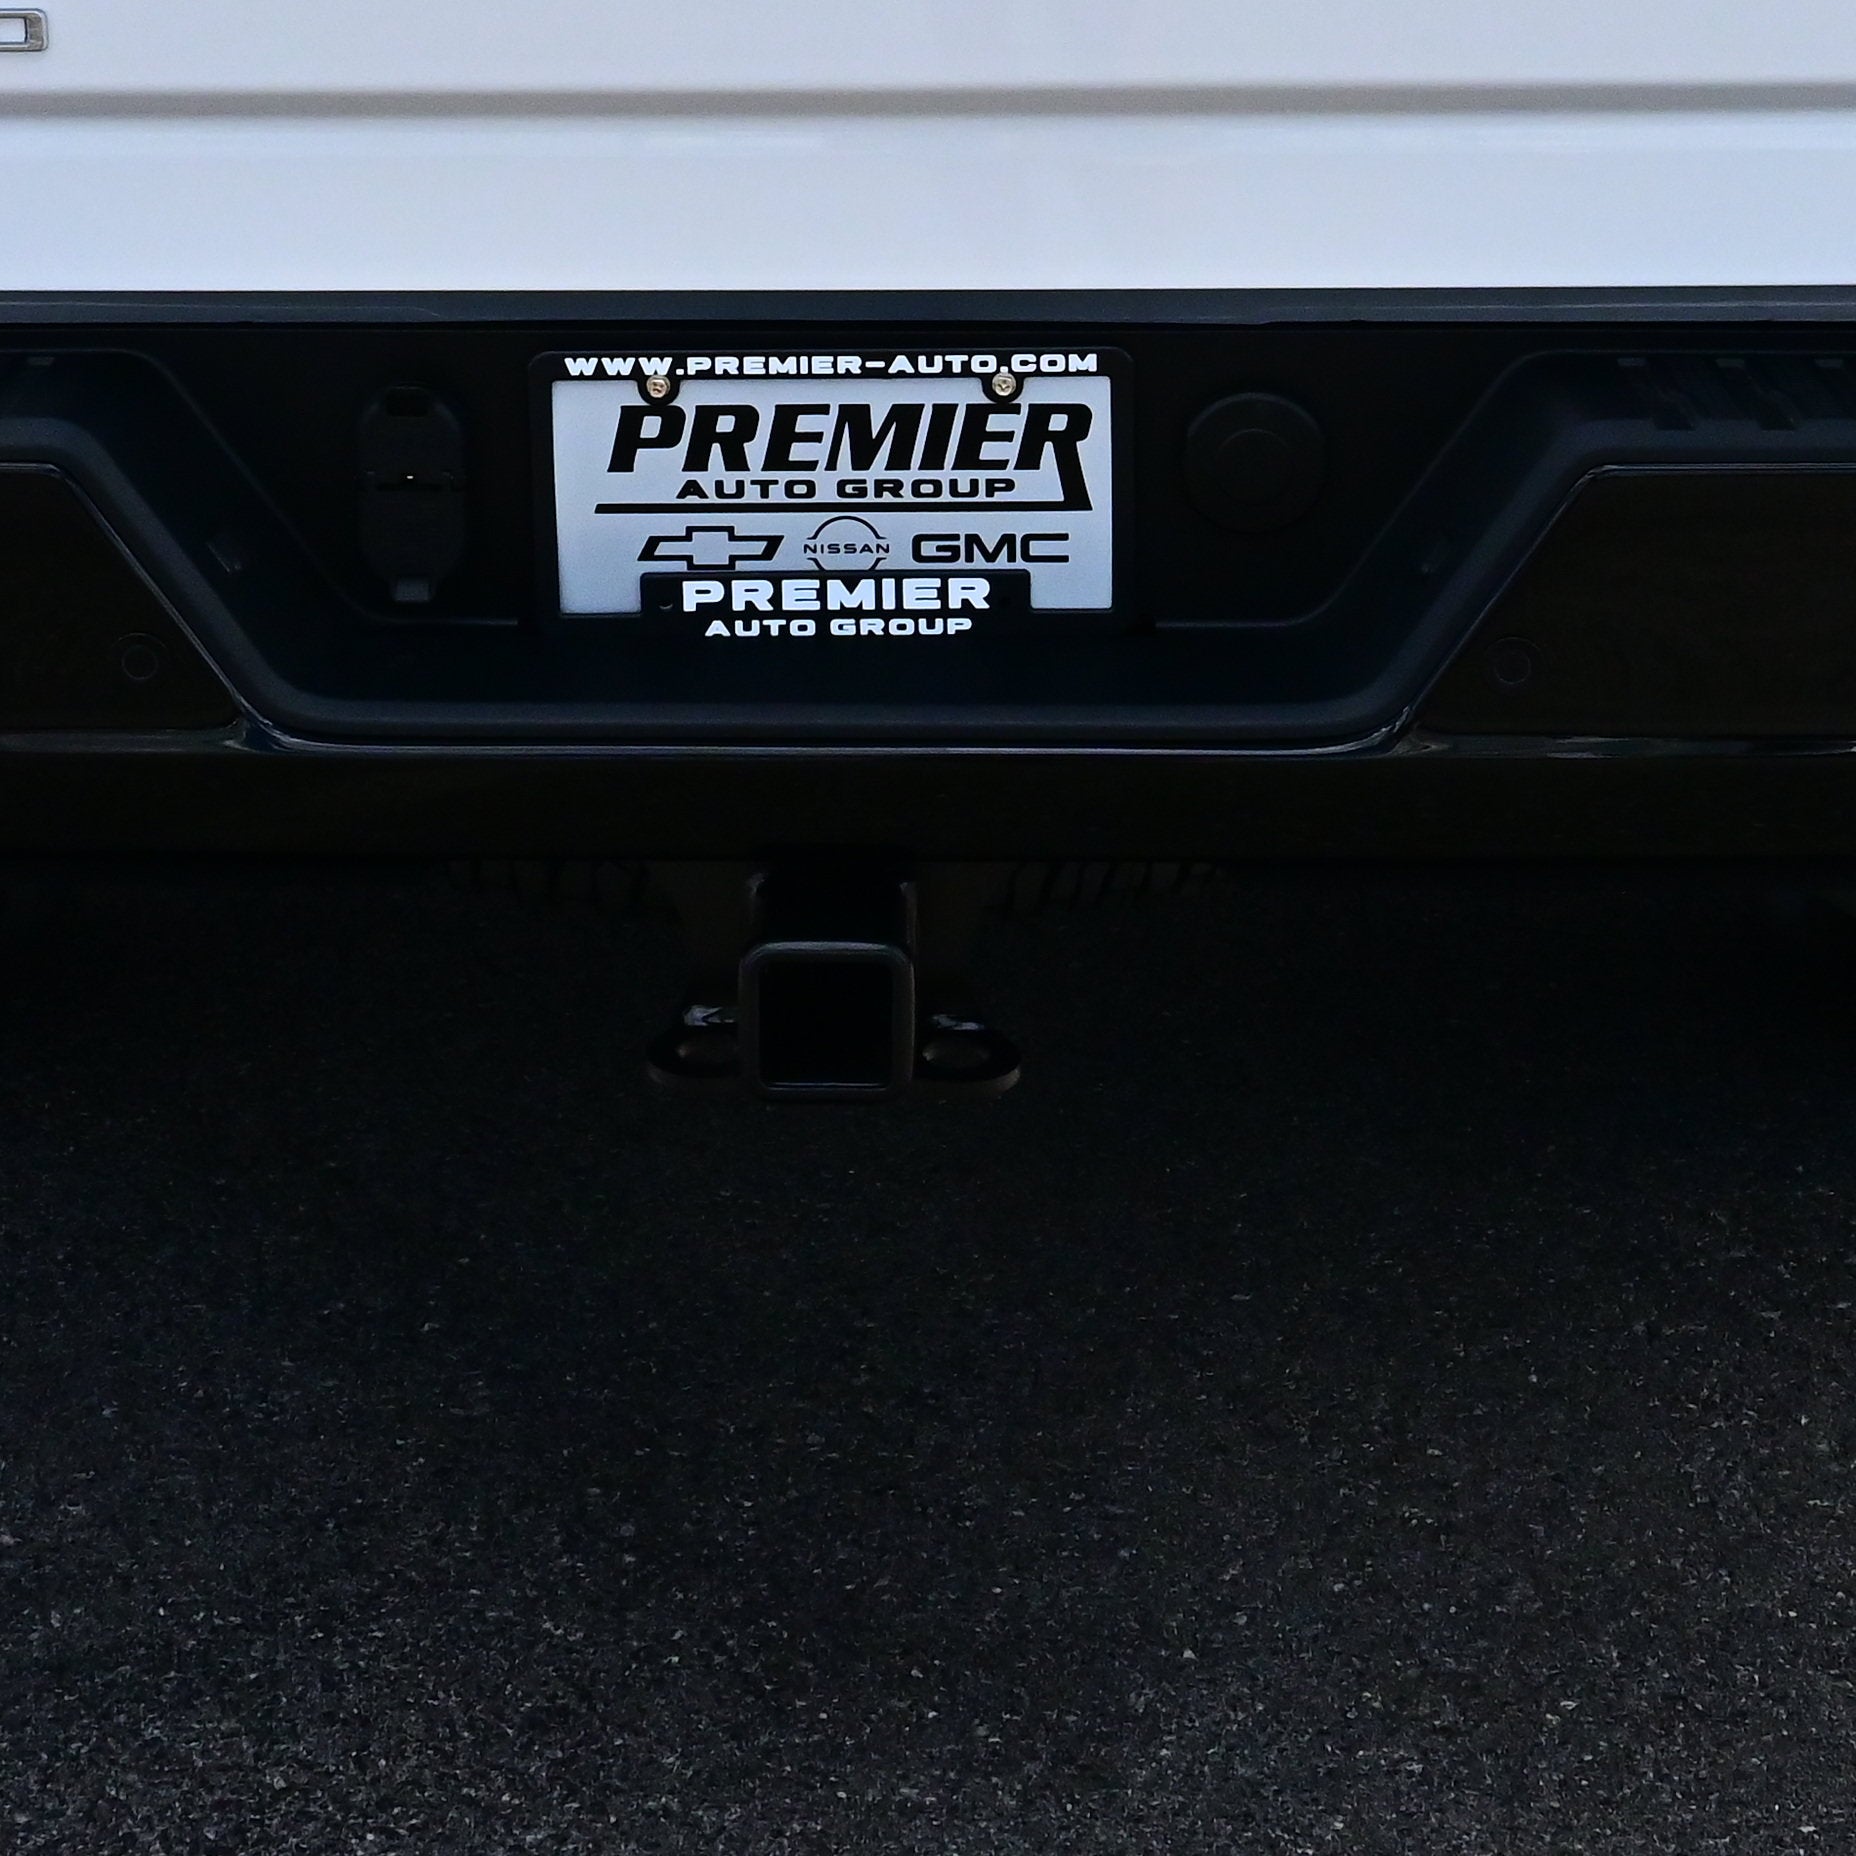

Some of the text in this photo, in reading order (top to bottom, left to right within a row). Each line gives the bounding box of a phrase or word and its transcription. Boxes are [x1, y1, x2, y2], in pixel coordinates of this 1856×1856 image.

[564, 354, 1098, 376] WWW.PREMIER-AUTO.COM
[607, 403, 1093, 474] PREMIER
[676, 477, 1016, 500] AUTO GROUP
[803, 543, 890, 555] NISSAN
[911, 533, 1070, 564] GMC
[682, 577, 991, 612] PREMIER
[706, 617, 973, 637] AUTO GROUP
